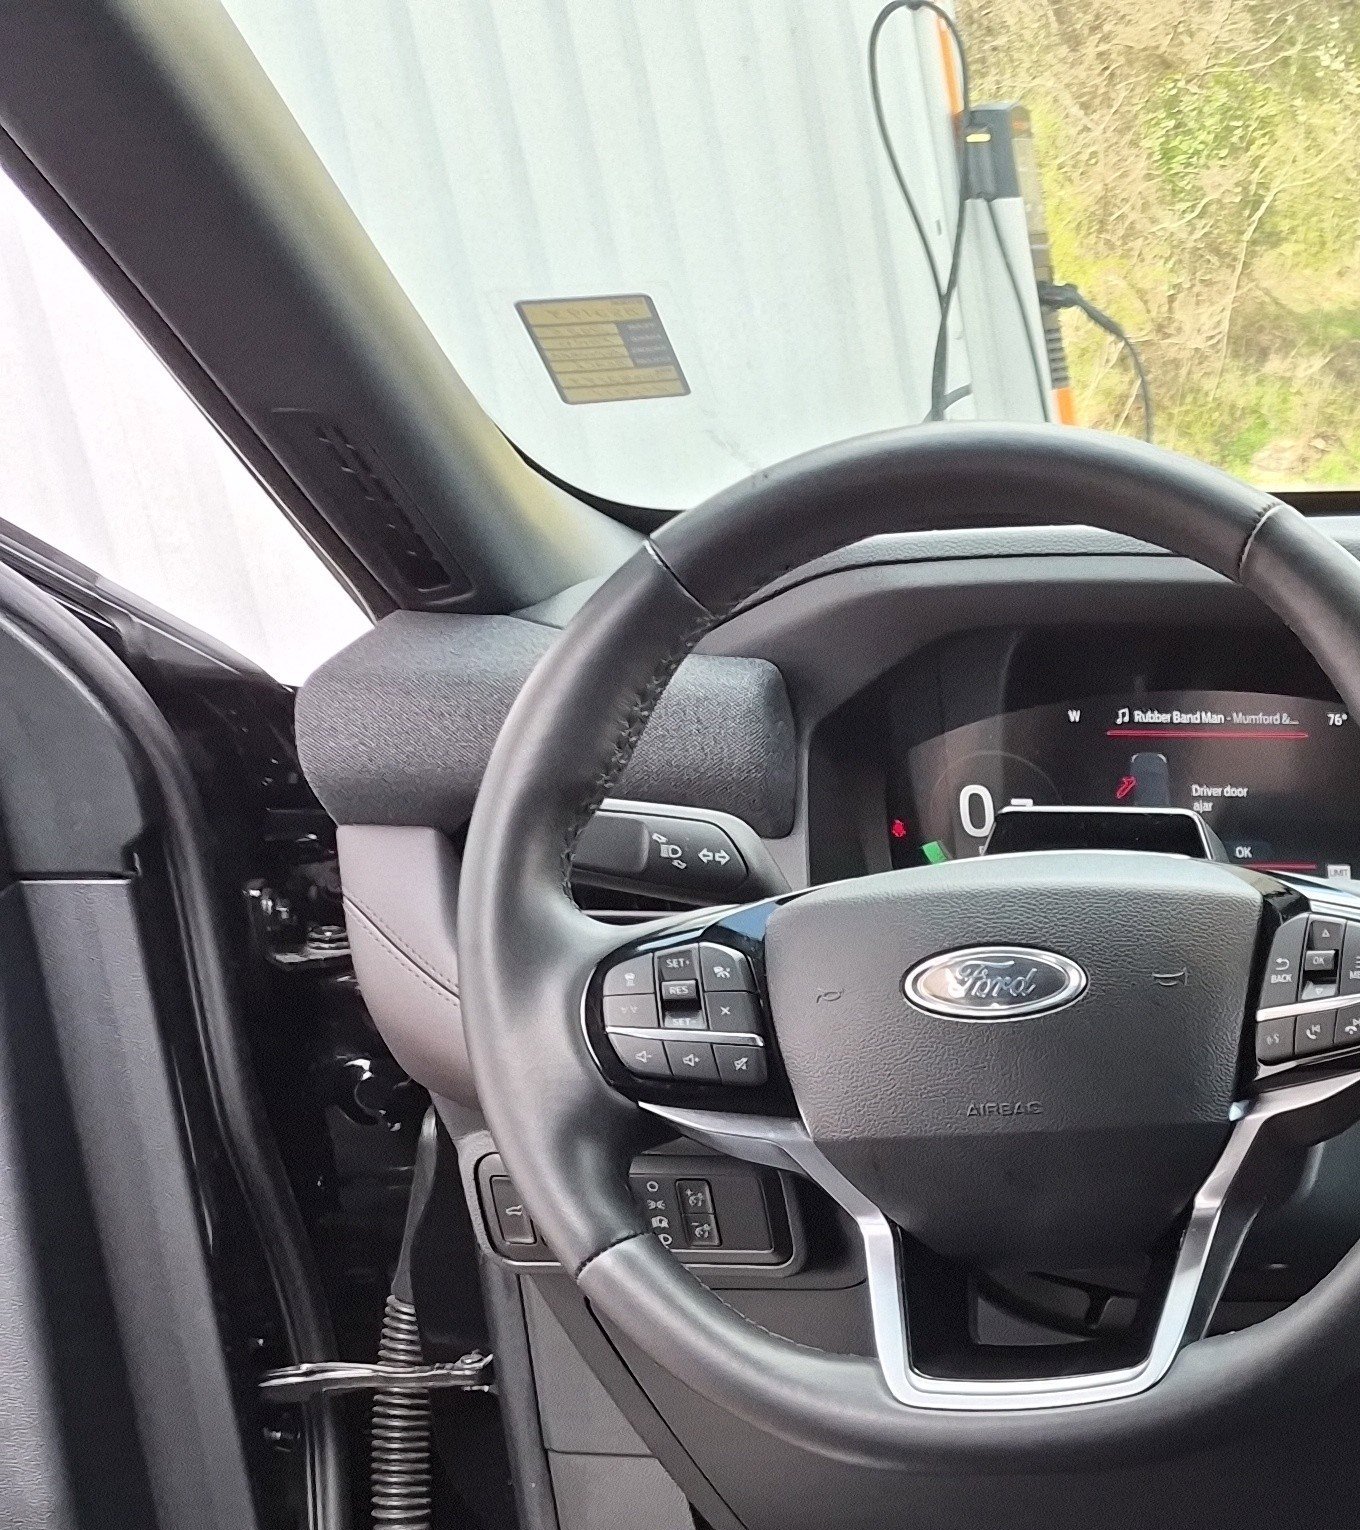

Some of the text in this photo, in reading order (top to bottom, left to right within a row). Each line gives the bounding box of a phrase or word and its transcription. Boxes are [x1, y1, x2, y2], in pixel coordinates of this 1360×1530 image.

[1068, 710, 1081, 722] W
[1133, 709, 1172, 723] Rubber
[1173, 711, 1200, 724] Band
[1201, 711, 1225, 724] Man
[1233, 711, 1281, 725] Mumford
[1192, 785, 1248, 798] Driver door
[1193, 801, 1213, 814] ajar
[1235, 846, 1253, 858] OK
[1312, 956, 1325, 965] OK
[947, 960, 1038, 998] Ford
[1270, 974, 1293, 984] BACK
[669, 985, 689, 995] RES
[966, 1100, 1043, 1117] AIRBAG
